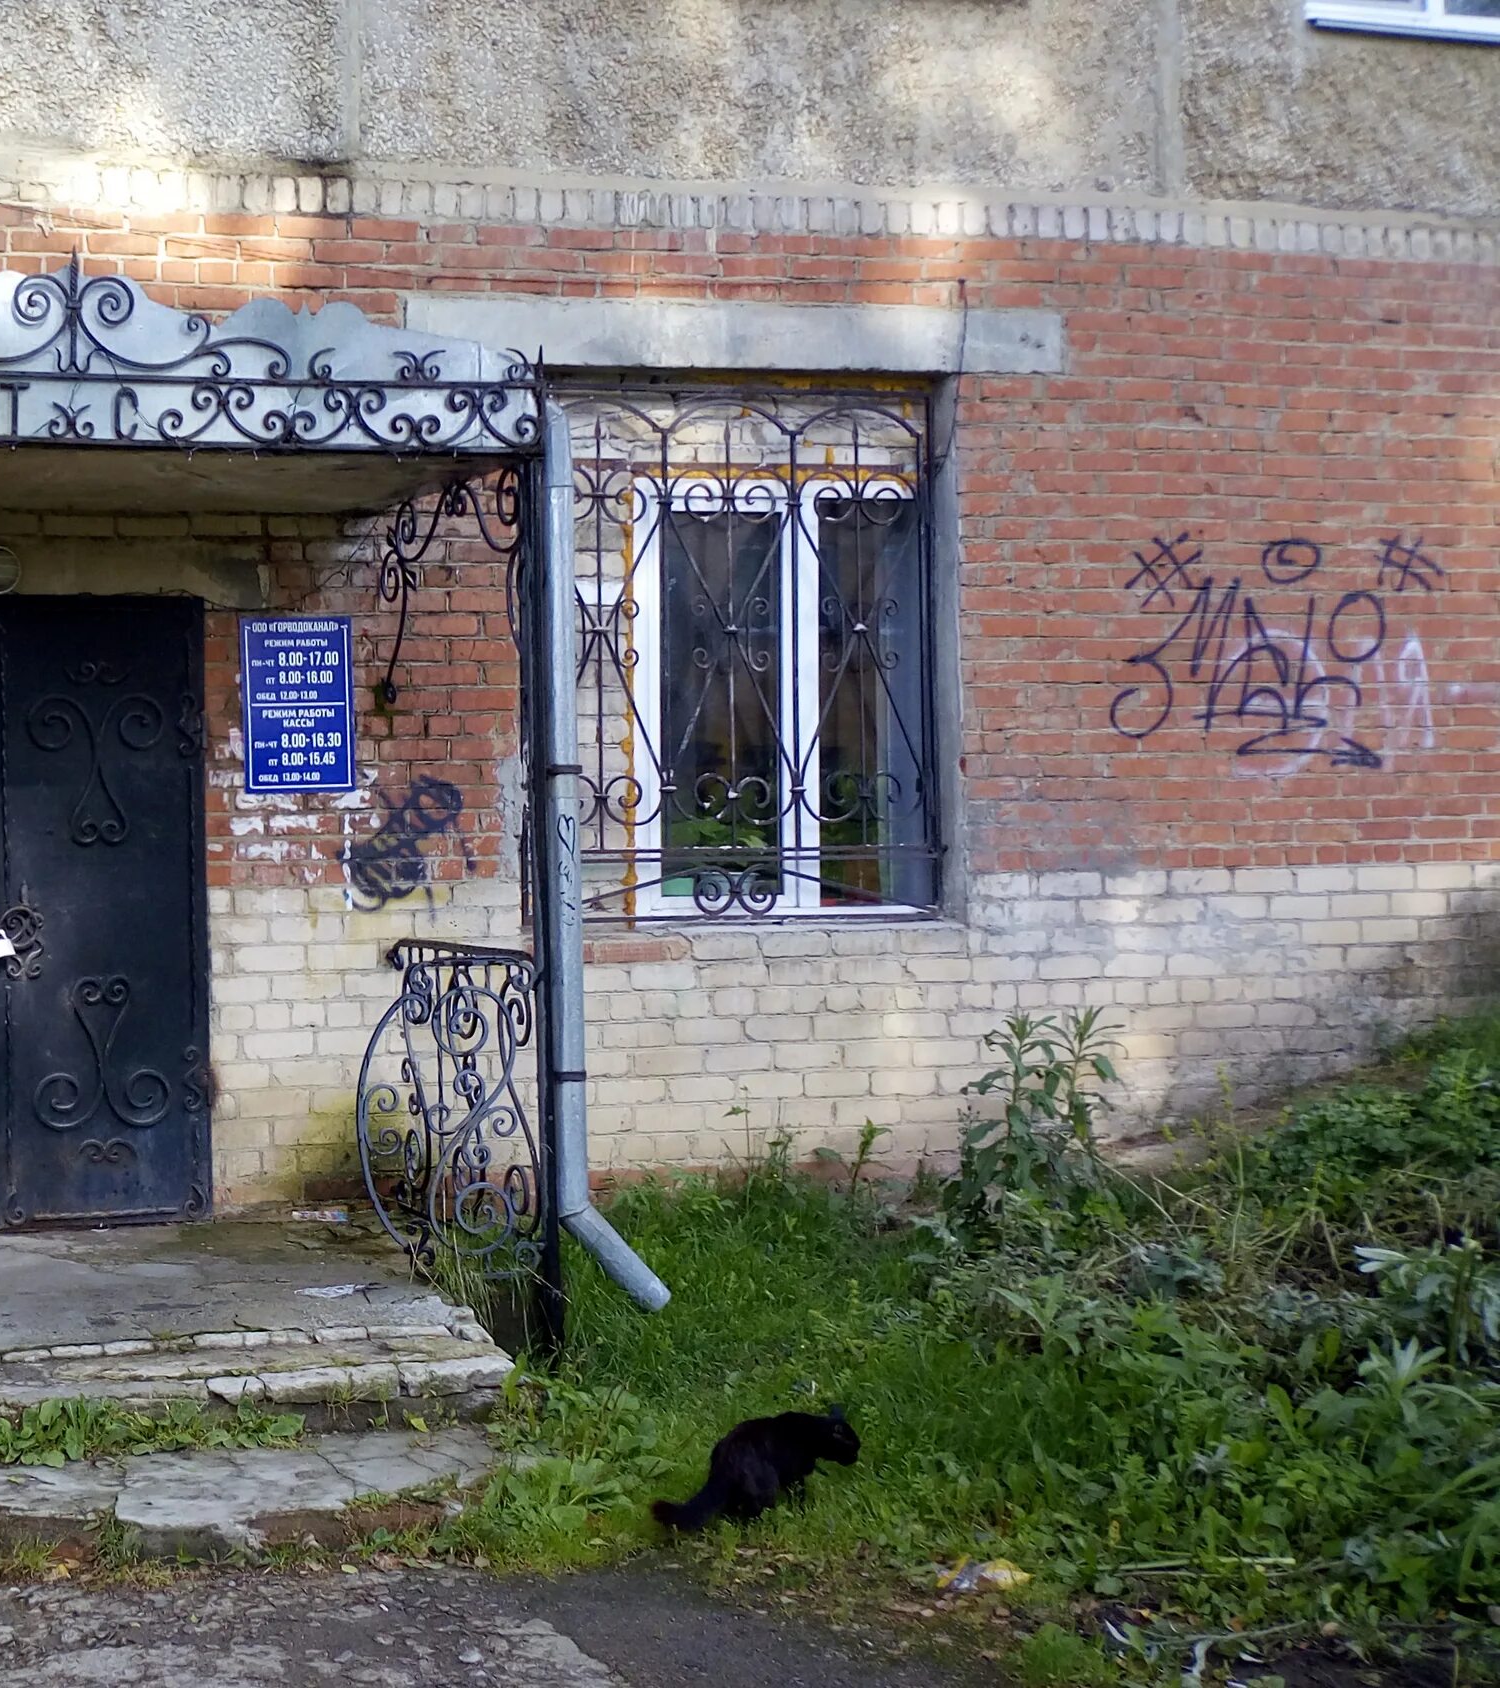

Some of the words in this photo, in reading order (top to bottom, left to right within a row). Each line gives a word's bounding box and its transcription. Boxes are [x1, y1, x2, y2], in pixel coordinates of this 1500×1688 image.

[252, 622, 267, 632] ООО
[296, 639, 328, 647] РАБОТЫ
[278, 652, 338, 666] 8.00-17.00
[279, 671, 333, 684] 8.00-16.00
[256, 692, 276, 700] ОБЕД
[280, 691, 318, 700] 12.00-13.00
[262, 710, 297, 718] РЕЖИМ
[299, 709, 334, 717] РАБОТЫ
[283, 719, 315, 727] КАССЫ
[281, 732, 341, 748] 8.00-16.30
[282, 752, 335, 765] 8.00-15.45
[259, 774, 278, 782] ОБЕД
[282, 772, 320, 781] 13.00-14.00
